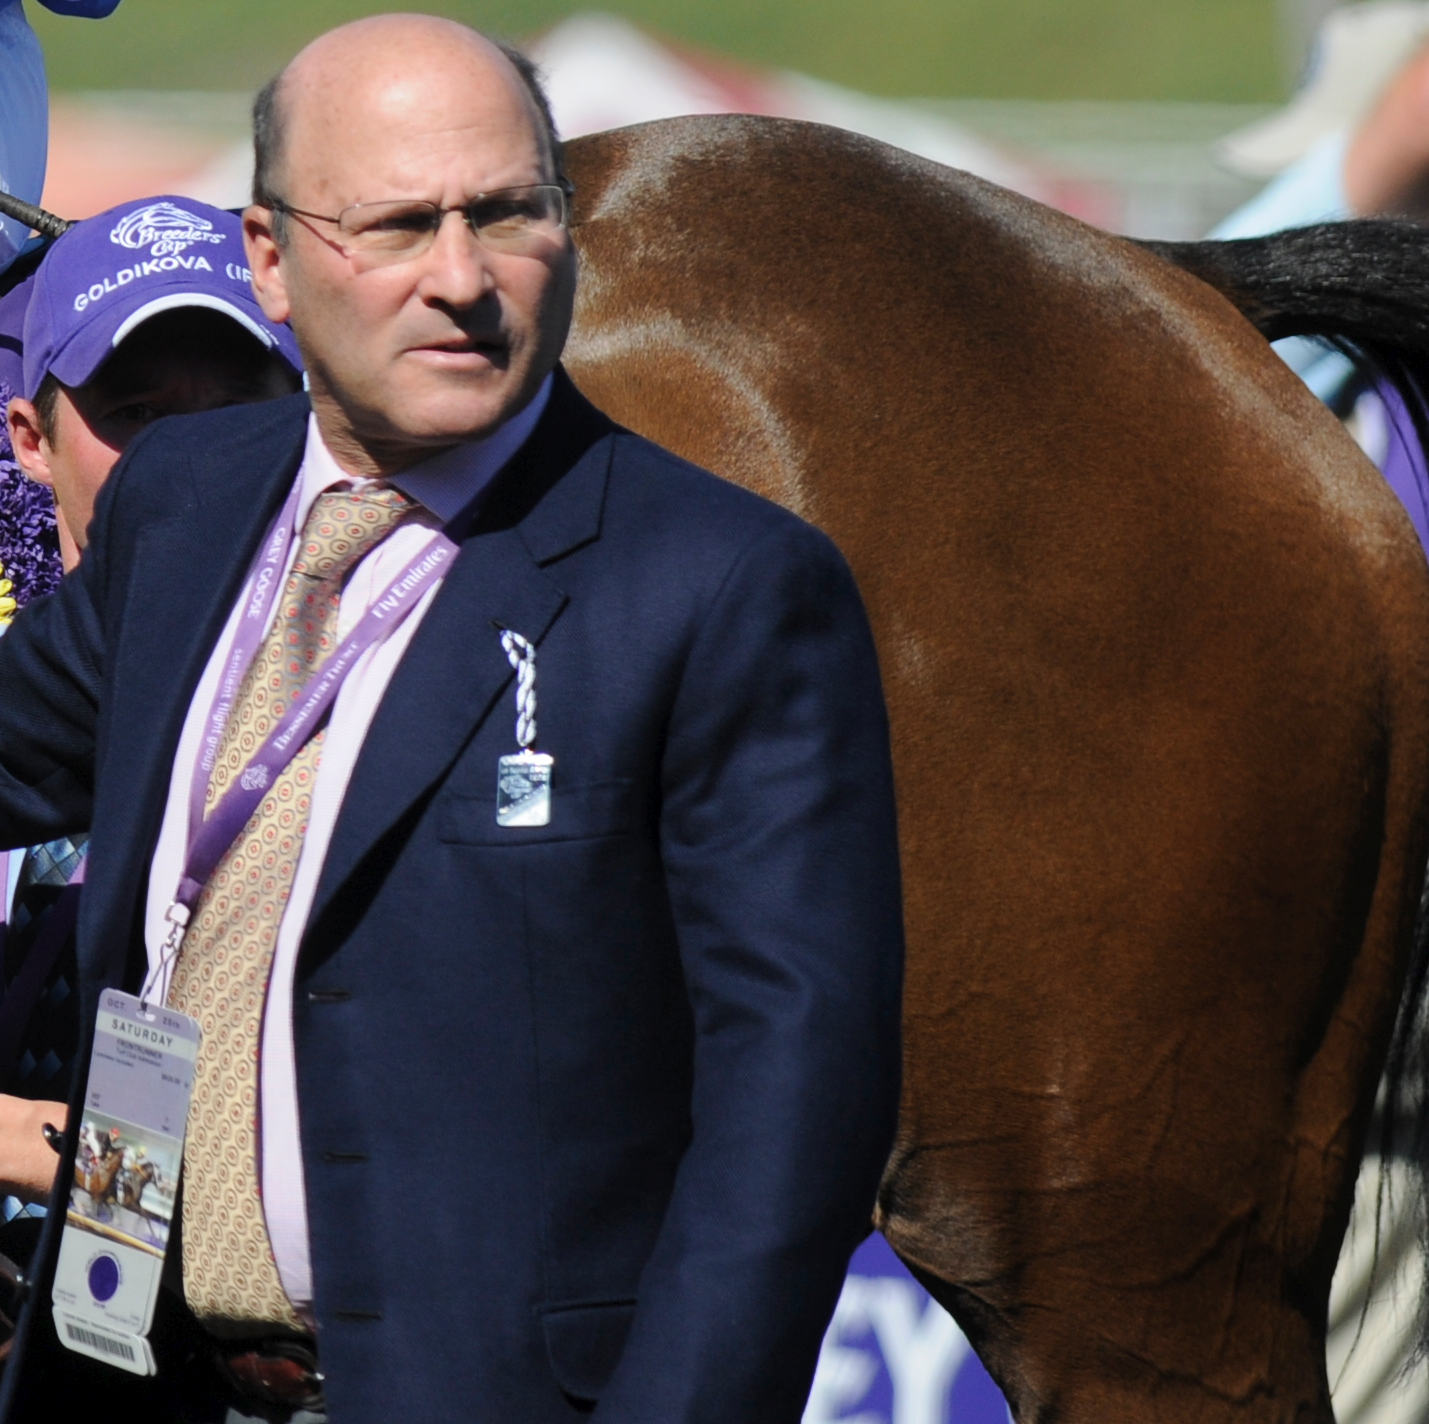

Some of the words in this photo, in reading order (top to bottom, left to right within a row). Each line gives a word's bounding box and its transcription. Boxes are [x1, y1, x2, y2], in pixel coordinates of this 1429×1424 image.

[150, 239, 188, 256] Cup
[73, 255, 214, 312] GOLDIKOVA
[247, 566, 274, 620] GOOSE
[370, 593, 400, 620] Fly
[396, 543, 448, 599] Emirates
[220, 648, 244, 699] sentient
[212, 702, 231, 735] flight
[200, 736, 219, 772] group
[111, 1018, 174, 1048] SATURDAY
